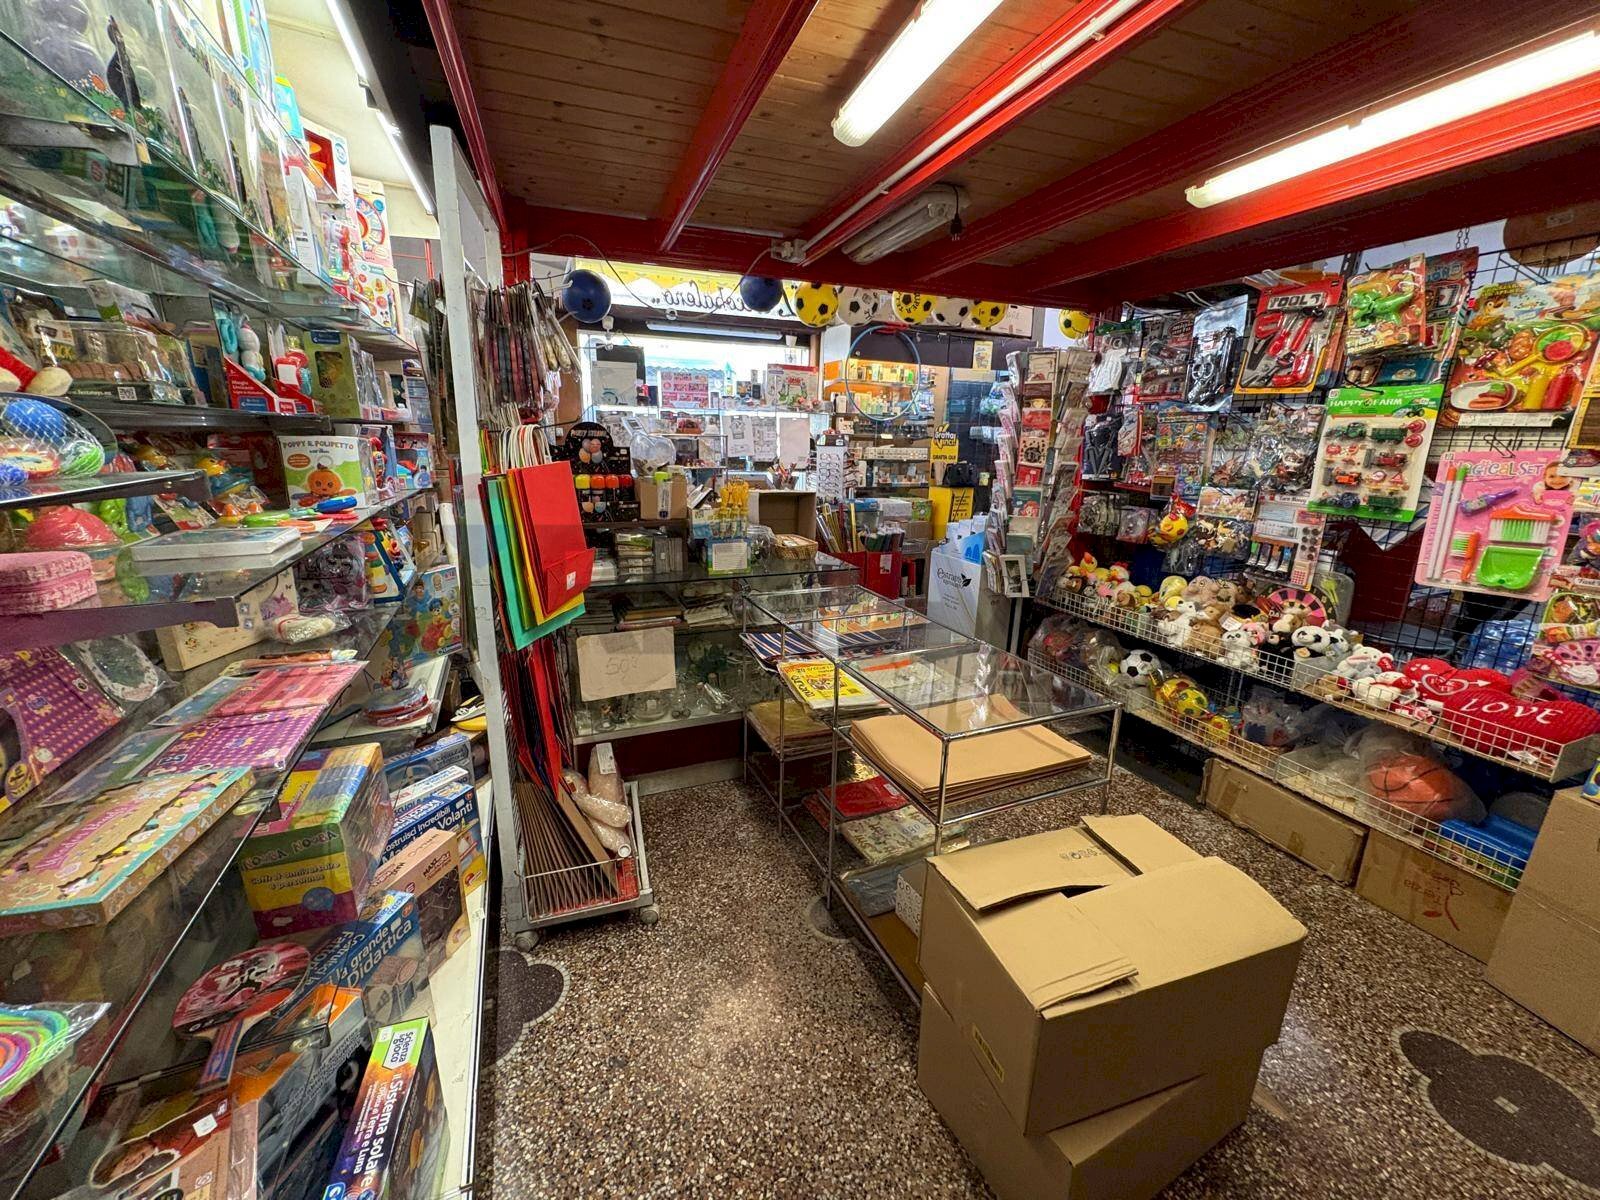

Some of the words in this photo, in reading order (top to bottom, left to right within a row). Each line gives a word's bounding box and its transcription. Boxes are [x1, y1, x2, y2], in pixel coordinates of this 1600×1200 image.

[1330, 399, 1362, 407] HAPPY
[1372, 398, 1402, 406] FARM
[1461, 698, 1563, 724] LOVE
[437, 800, 473, 830] Volanti
[347, 919, 412, 988] Didattica
[350, 926, 389, 971] grande
[399, 1031, 413, 1063] scienza
[375, 1079, 403, 1136] Sistema
[364, 1113, 377, 1140] Terra
[353, 1149, 364, 1174] Luna
[360, 1138, 385, 1188] solare
